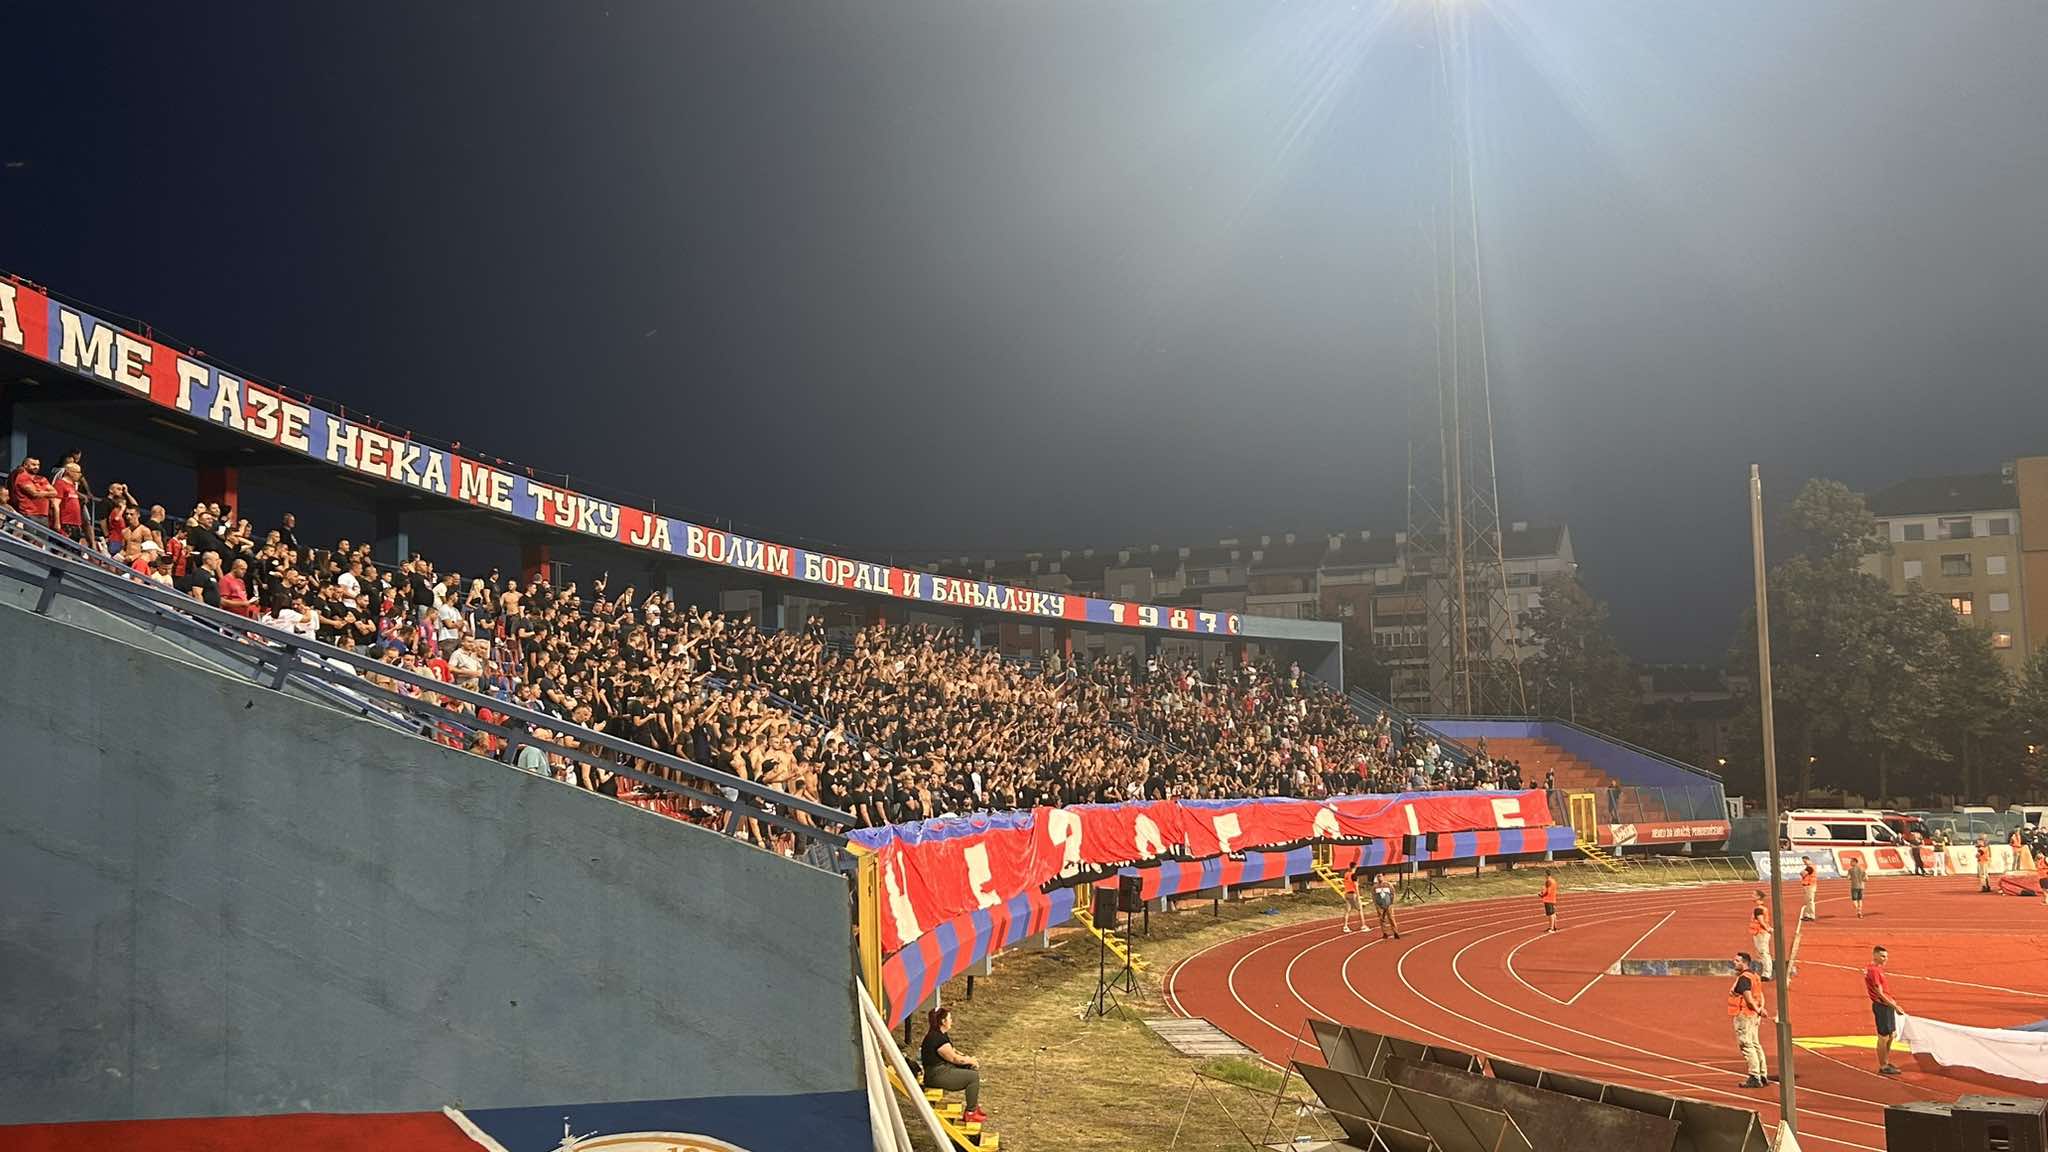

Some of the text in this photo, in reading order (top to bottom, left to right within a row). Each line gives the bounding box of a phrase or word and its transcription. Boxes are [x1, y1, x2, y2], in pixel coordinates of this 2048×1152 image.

[59, 307, 152, 395] МЕ
[175, 356, 312, 453] ГАЗЕ
[325, 416, 448, 494] НЕКА
[458, 461, 515, 511] МЕ
[527, 481, 622, 539] ТУКУ
[630, 514, 673, 552] ЈА
[686, 525, 790, 576] ВОЛИМ
[803, 552, 895, 595] БОРАЦ
[902, 572, 922, 598] И
[931, 575, 1066, 618] БАЊАЛУКУ
